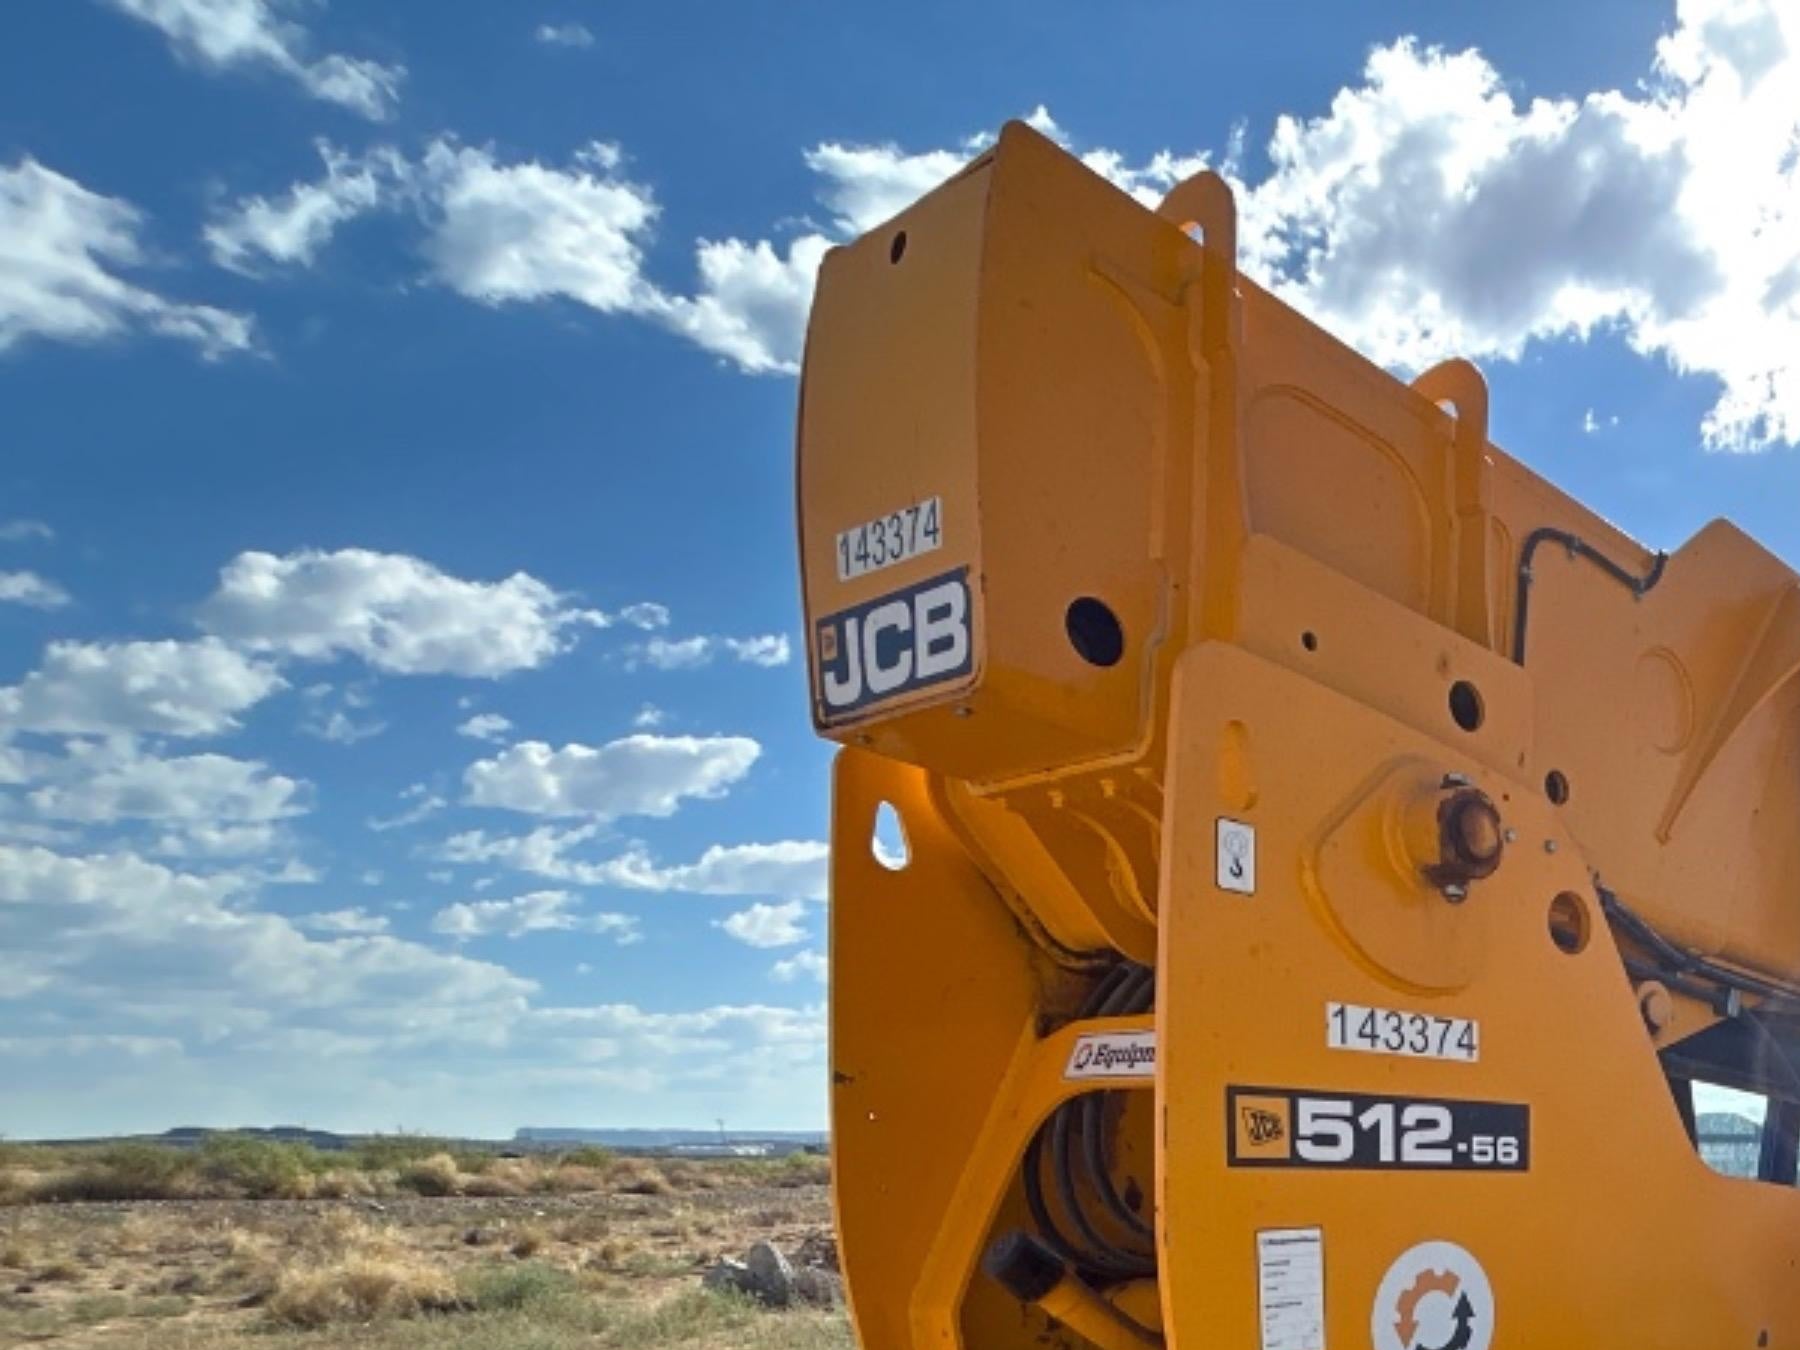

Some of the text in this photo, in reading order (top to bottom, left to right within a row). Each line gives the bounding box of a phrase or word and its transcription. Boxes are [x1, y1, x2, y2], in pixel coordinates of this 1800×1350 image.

[839, 500, 939, 576] 143374
[824, 581, 967, 706] JCB
[1331, 1005, 1477, 1058] 143374
